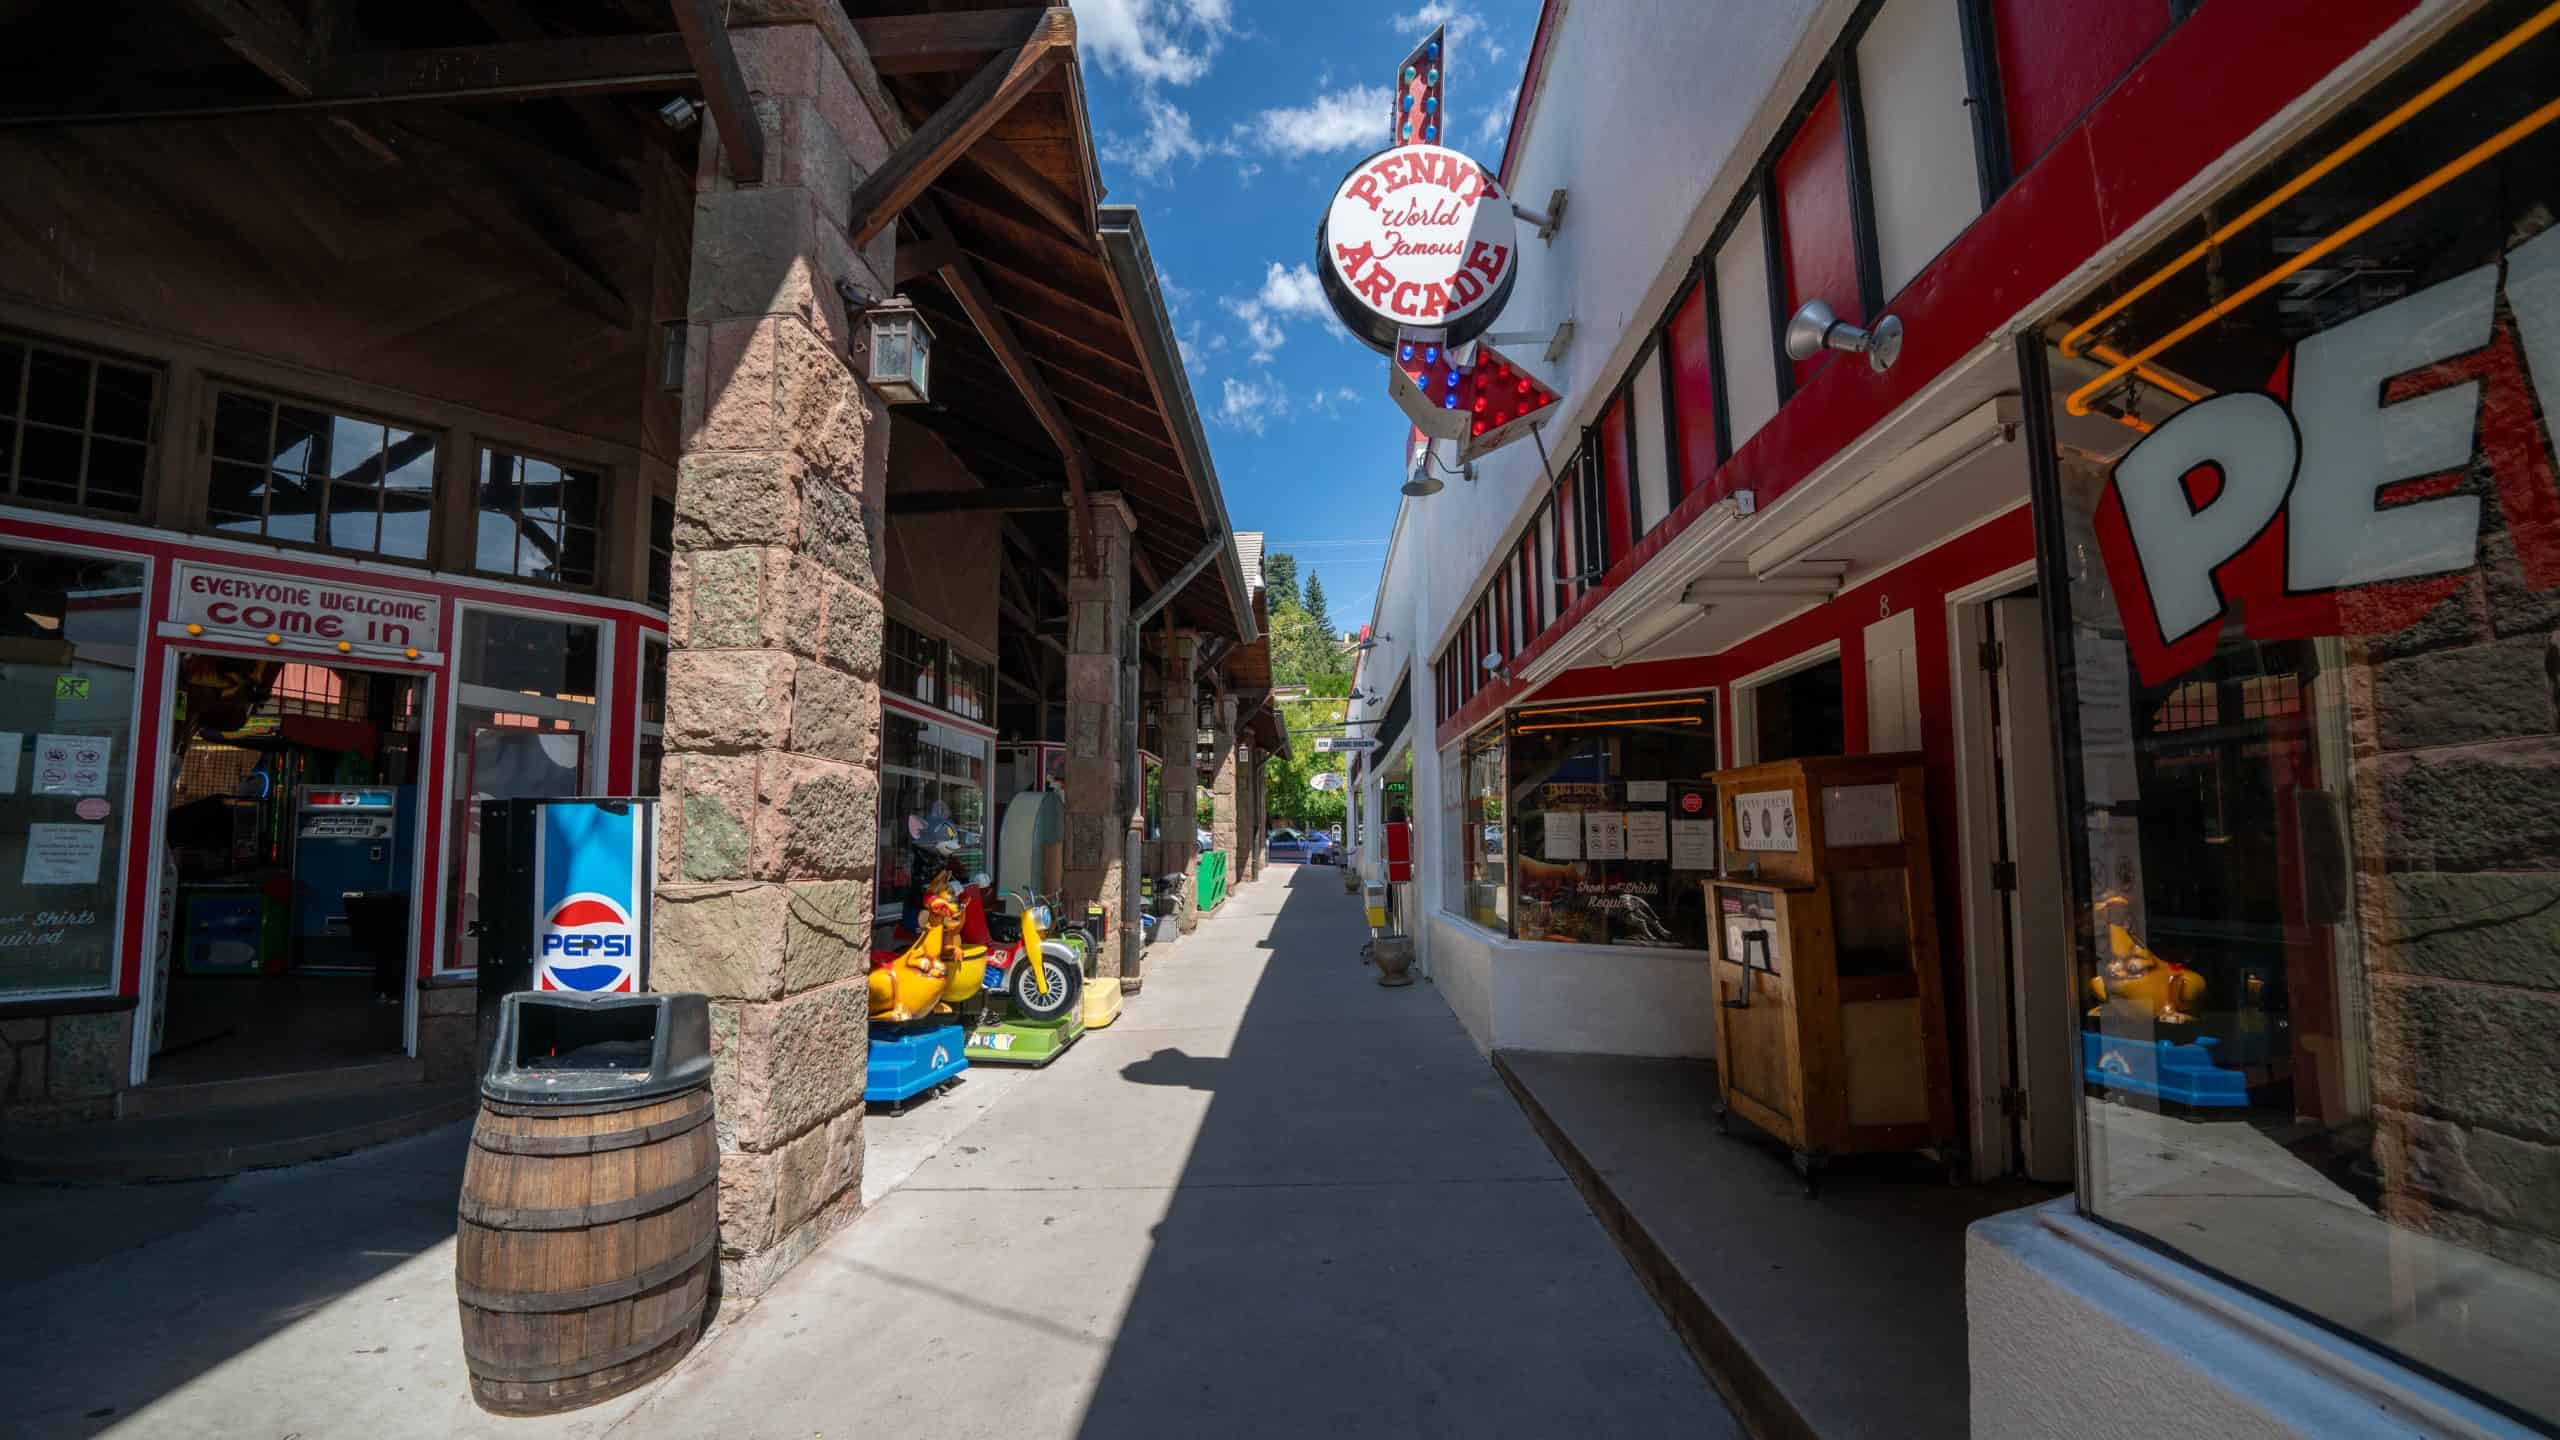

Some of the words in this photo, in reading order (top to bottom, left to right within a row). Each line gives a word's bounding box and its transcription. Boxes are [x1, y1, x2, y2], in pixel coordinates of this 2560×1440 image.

[1345, 152, 1499, 212] PENNY
[1382, 197, 1461, 226] World
[1373, 231, 1463, 260] Famous
[1336, 240, 1508, 317] ARCADE
[190, 575, 310, 606] EVERYONE
[319, 591, 426, 621] WELCOME
[1879, 593, 1890, 618] 8
[207, 602, 343, 638] COME
[1387, 783, 1406, 792] ATM
[32, 910, 96, 926] Shirts
[543, 934, 631, 957] PEPSI
